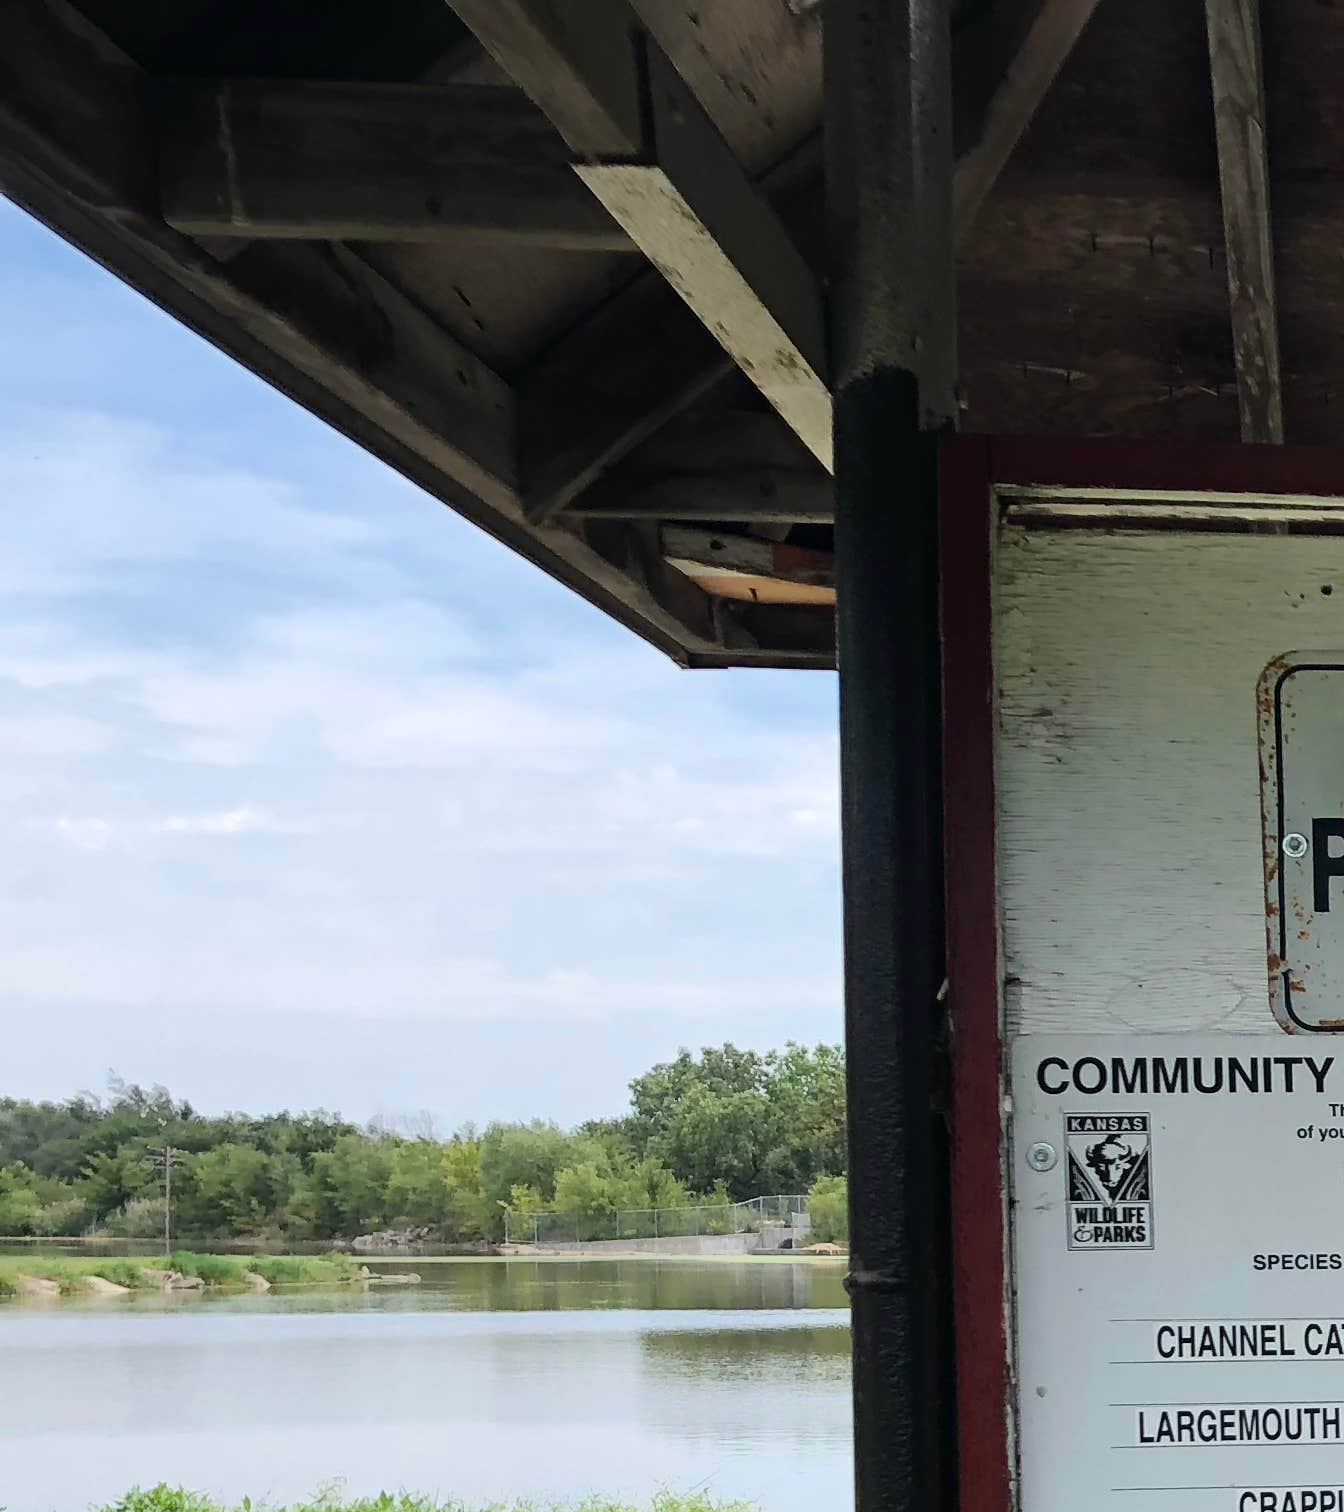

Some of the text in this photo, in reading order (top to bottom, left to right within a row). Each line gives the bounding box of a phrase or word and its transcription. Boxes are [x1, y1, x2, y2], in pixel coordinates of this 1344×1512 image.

[1037, 1058, 1334, 1095] COMMUNITY
[1072, 1118, 1142, 1130] KANSAS
[1075, 1208, 1145, 1223] WILDLIFE
[1094, 1226, 1146, 1242] PARKS
[1253, 1254, 1342, 1270] SPECIES
[1156, 1325, 1295, 1358] CHANNEL
[1139, 1408, 1340, 1443] LARGEMOUTH
